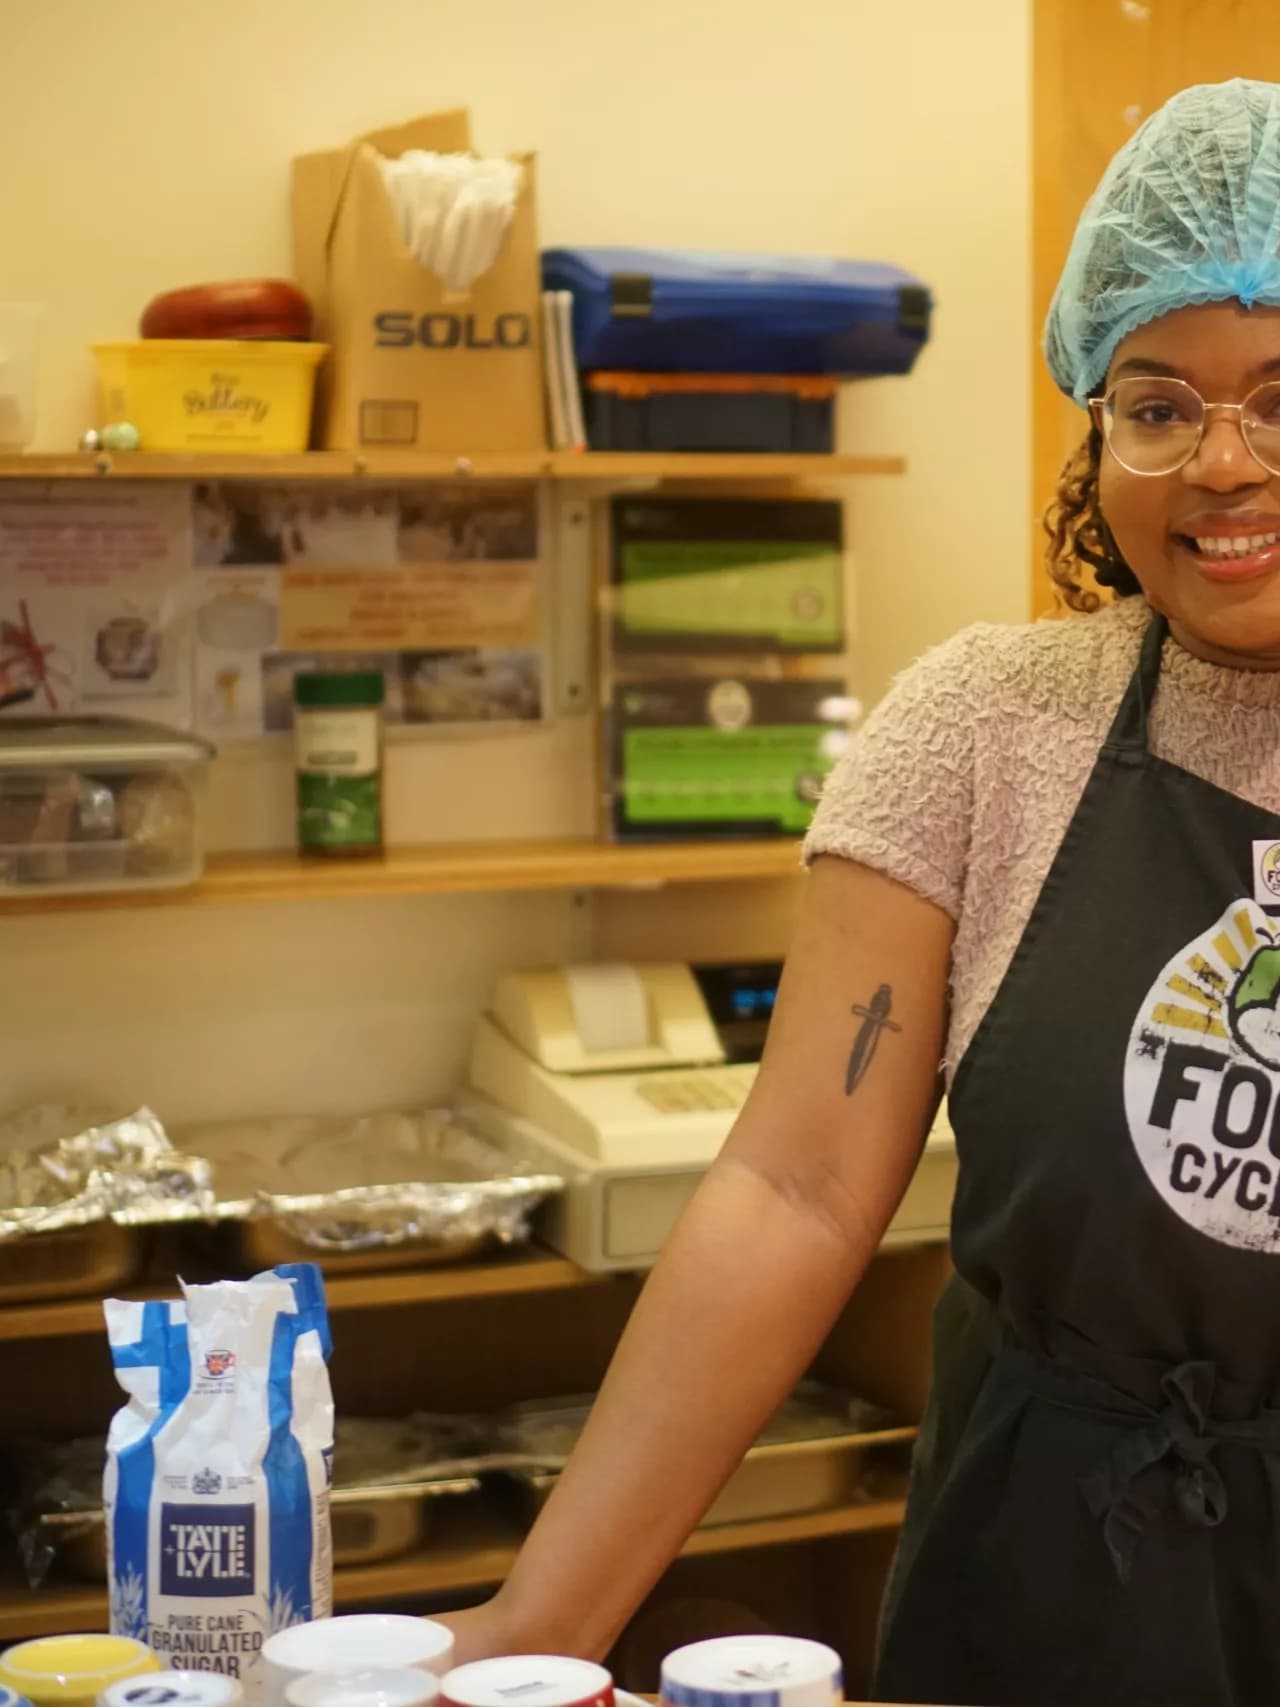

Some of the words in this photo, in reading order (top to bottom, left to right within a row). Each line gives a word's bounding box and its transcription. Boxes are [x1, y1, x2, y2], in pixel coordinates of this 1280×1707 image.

[373, 311, 533, 350] SOLO
[169, 1524, 246, 1551] TATE
[176, 1551, 246, 1579] LYLE
[168, 1614, 203, 1631] PURE
[206, 1614, 245, 1632] CANE
[152, 1631, 264, 1653] GRANULATED
[170, 1655, 241, 1680] SUGAR
